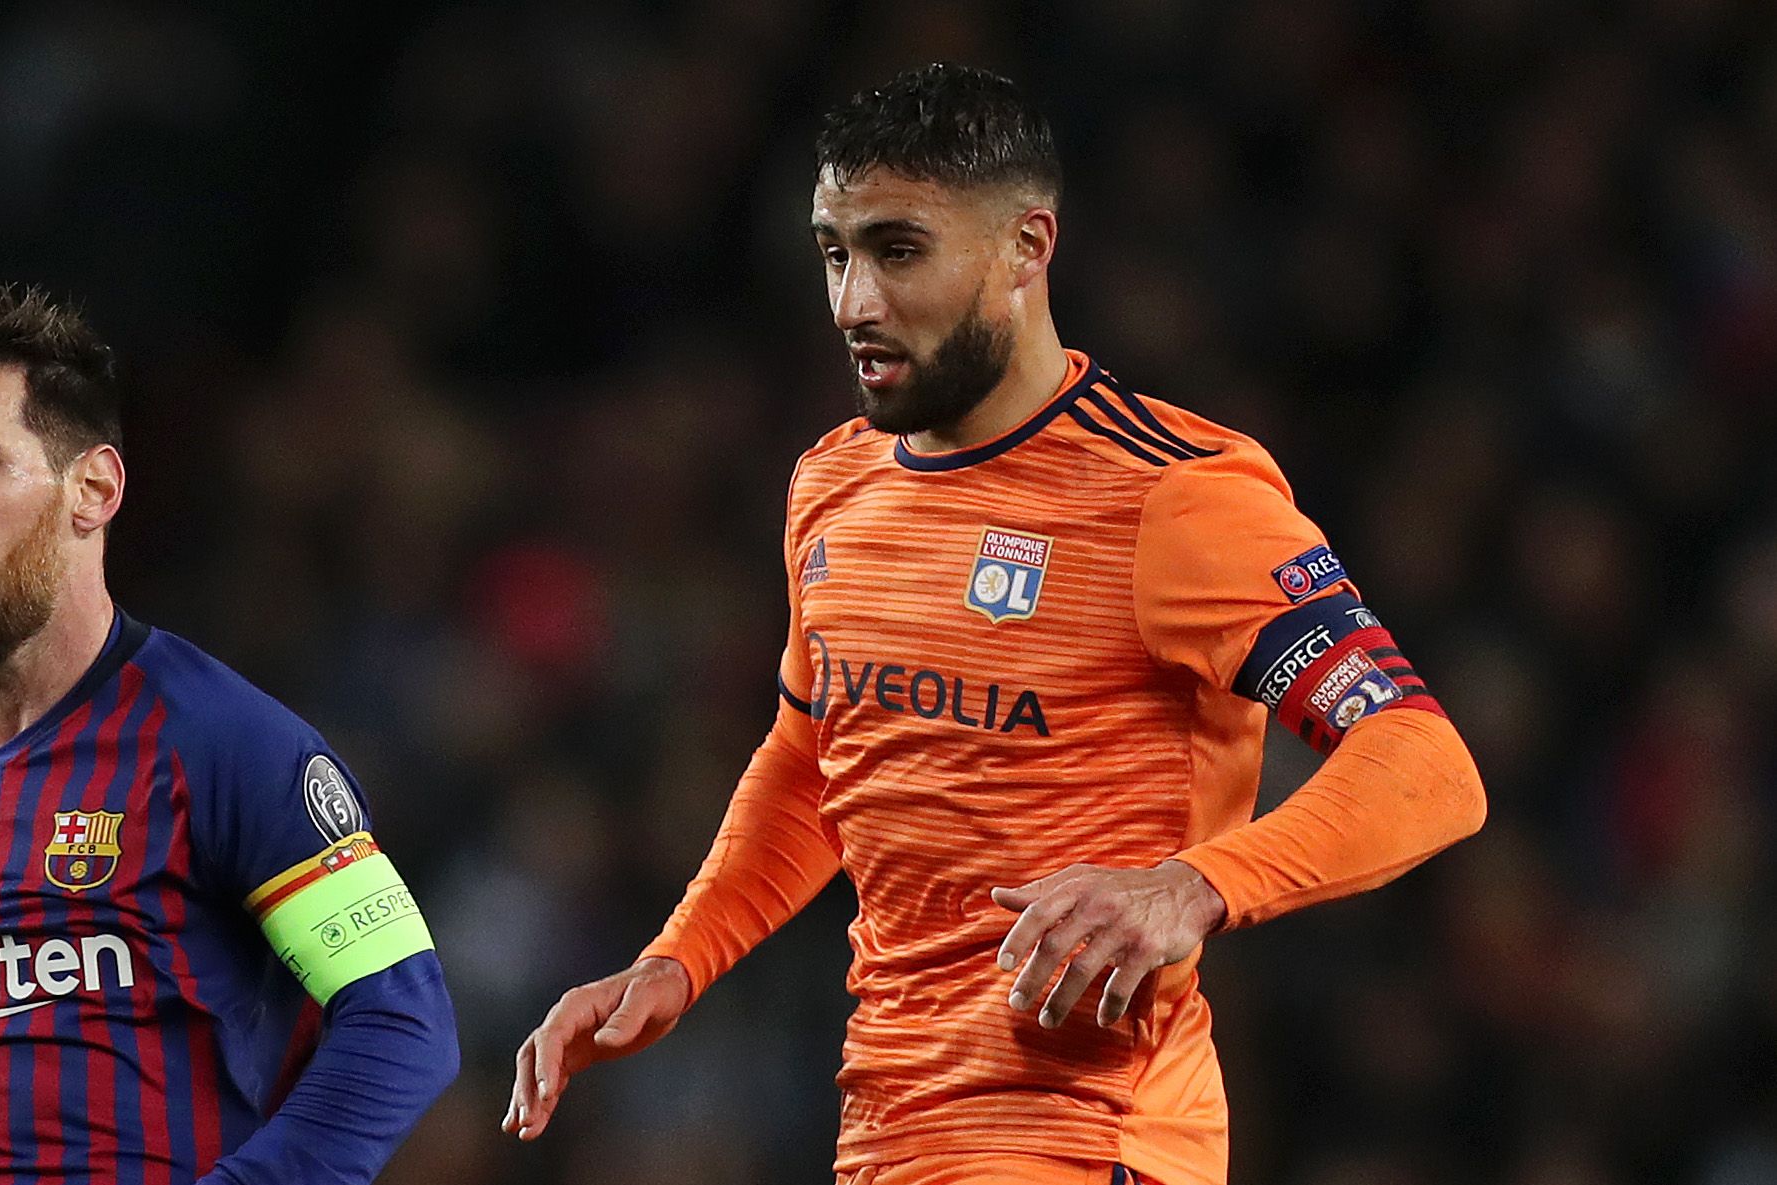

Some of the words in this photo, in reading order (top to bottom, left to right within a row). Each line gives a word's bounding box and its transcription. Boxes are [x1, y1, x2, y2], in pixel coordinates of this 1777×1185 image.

[982, 543, 1043, 565] LYONNAIS
[985, 532, 1047, 554] OLYMPIQUE
[1261, 629, 1335, 710] RESPECT
[1310, 652, 1363, 705] OLYMPIQUE
[840, 658, 1051, 737] VEOLIA
[332, 800, 348, 825] 5
[67, 844, 96, 854] FCB
